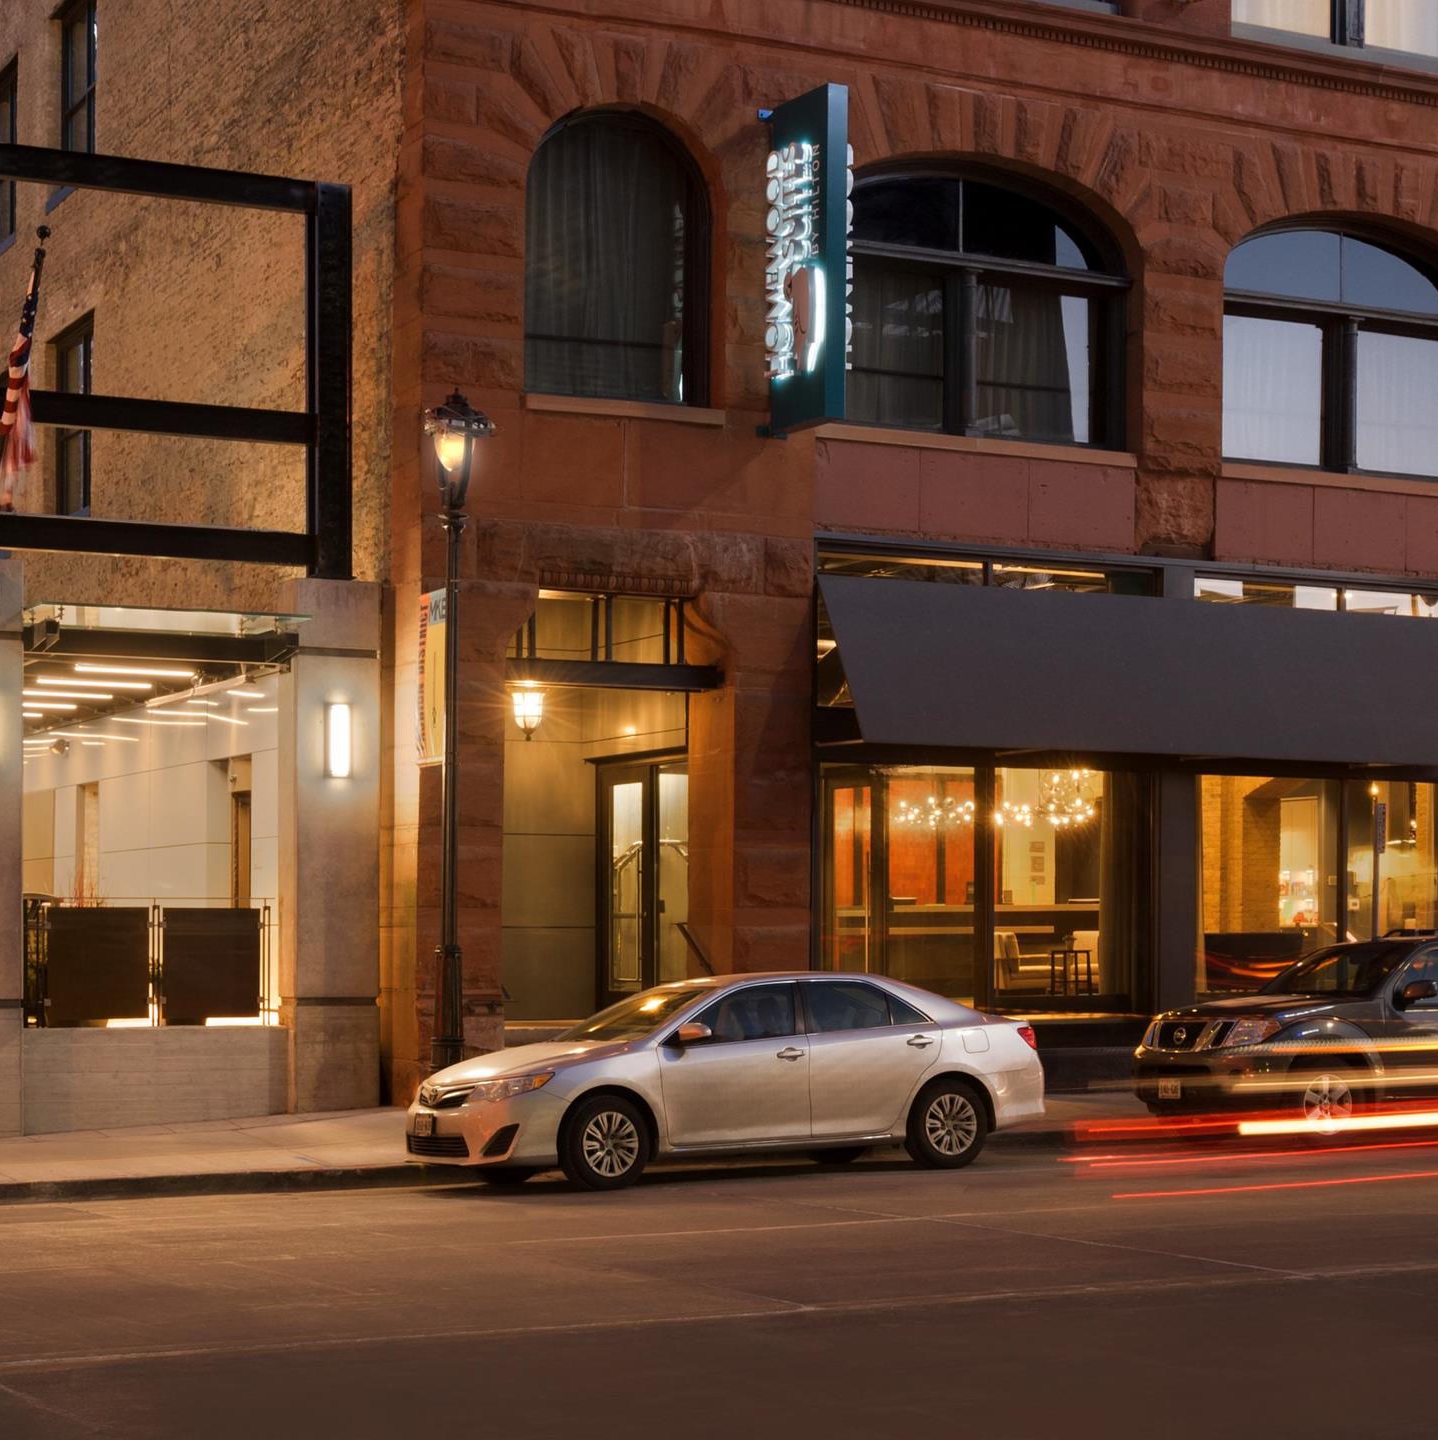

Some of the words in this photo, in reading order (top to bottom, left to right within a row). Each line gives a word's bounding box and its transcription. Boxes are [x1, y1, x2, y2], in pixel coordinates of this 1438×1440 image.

[781, 142, 806, 259] SUITES
[811, 143, 820, 220] HILTON
[764, 151, 789, 379] HOMEWOOD
[811, 230, 820, 256] BY
